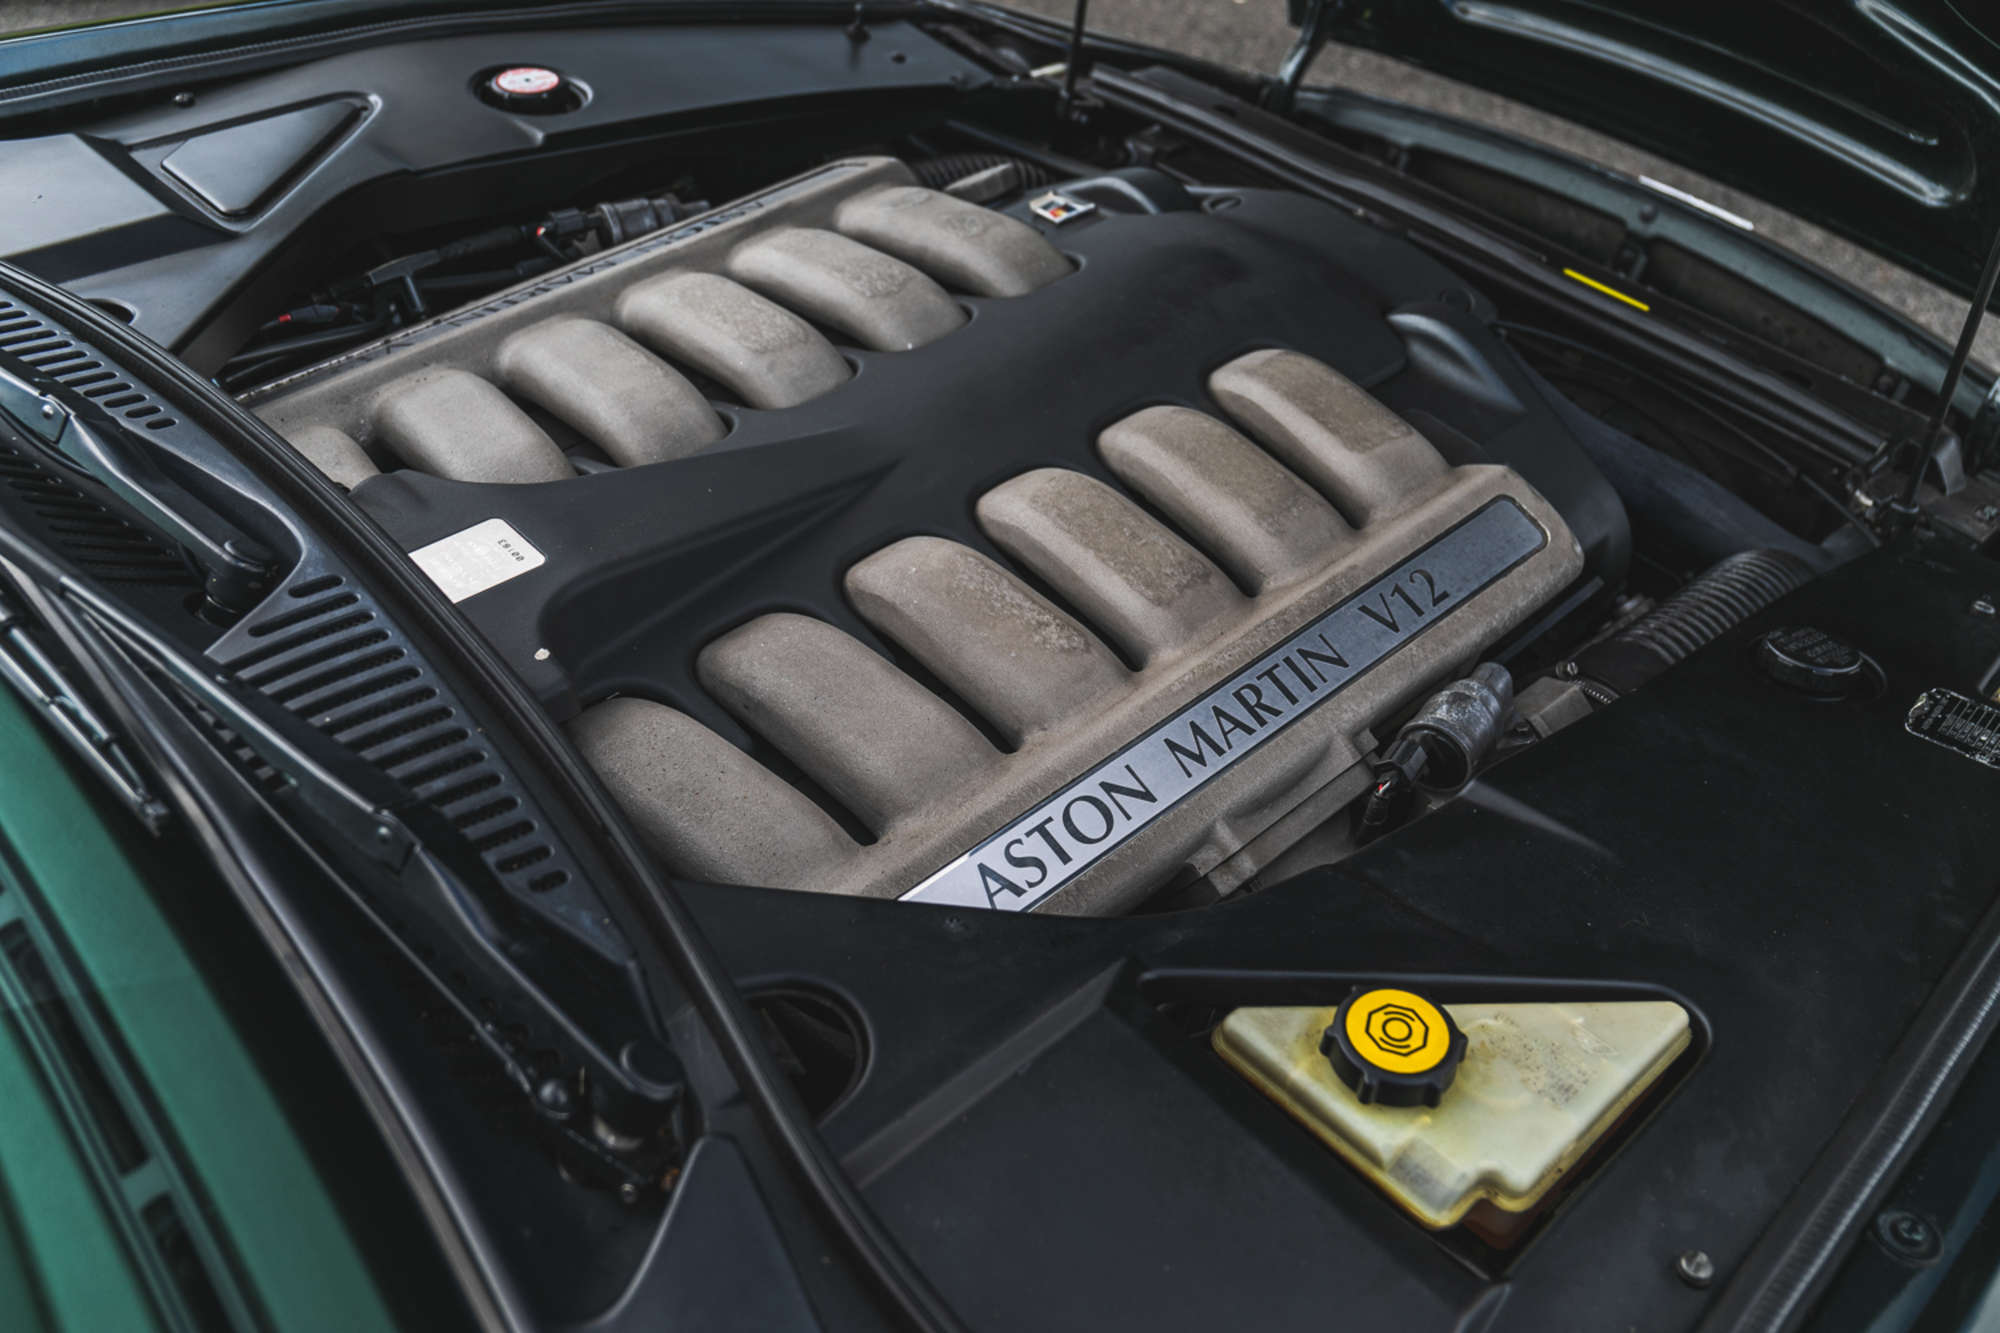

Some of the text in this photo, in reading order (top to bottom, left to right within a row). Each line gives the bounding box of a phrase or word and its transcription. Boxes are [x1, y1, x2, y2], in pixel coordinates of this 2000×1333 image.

[977, 568, 1450, 910] ASTON MARTIN V12
